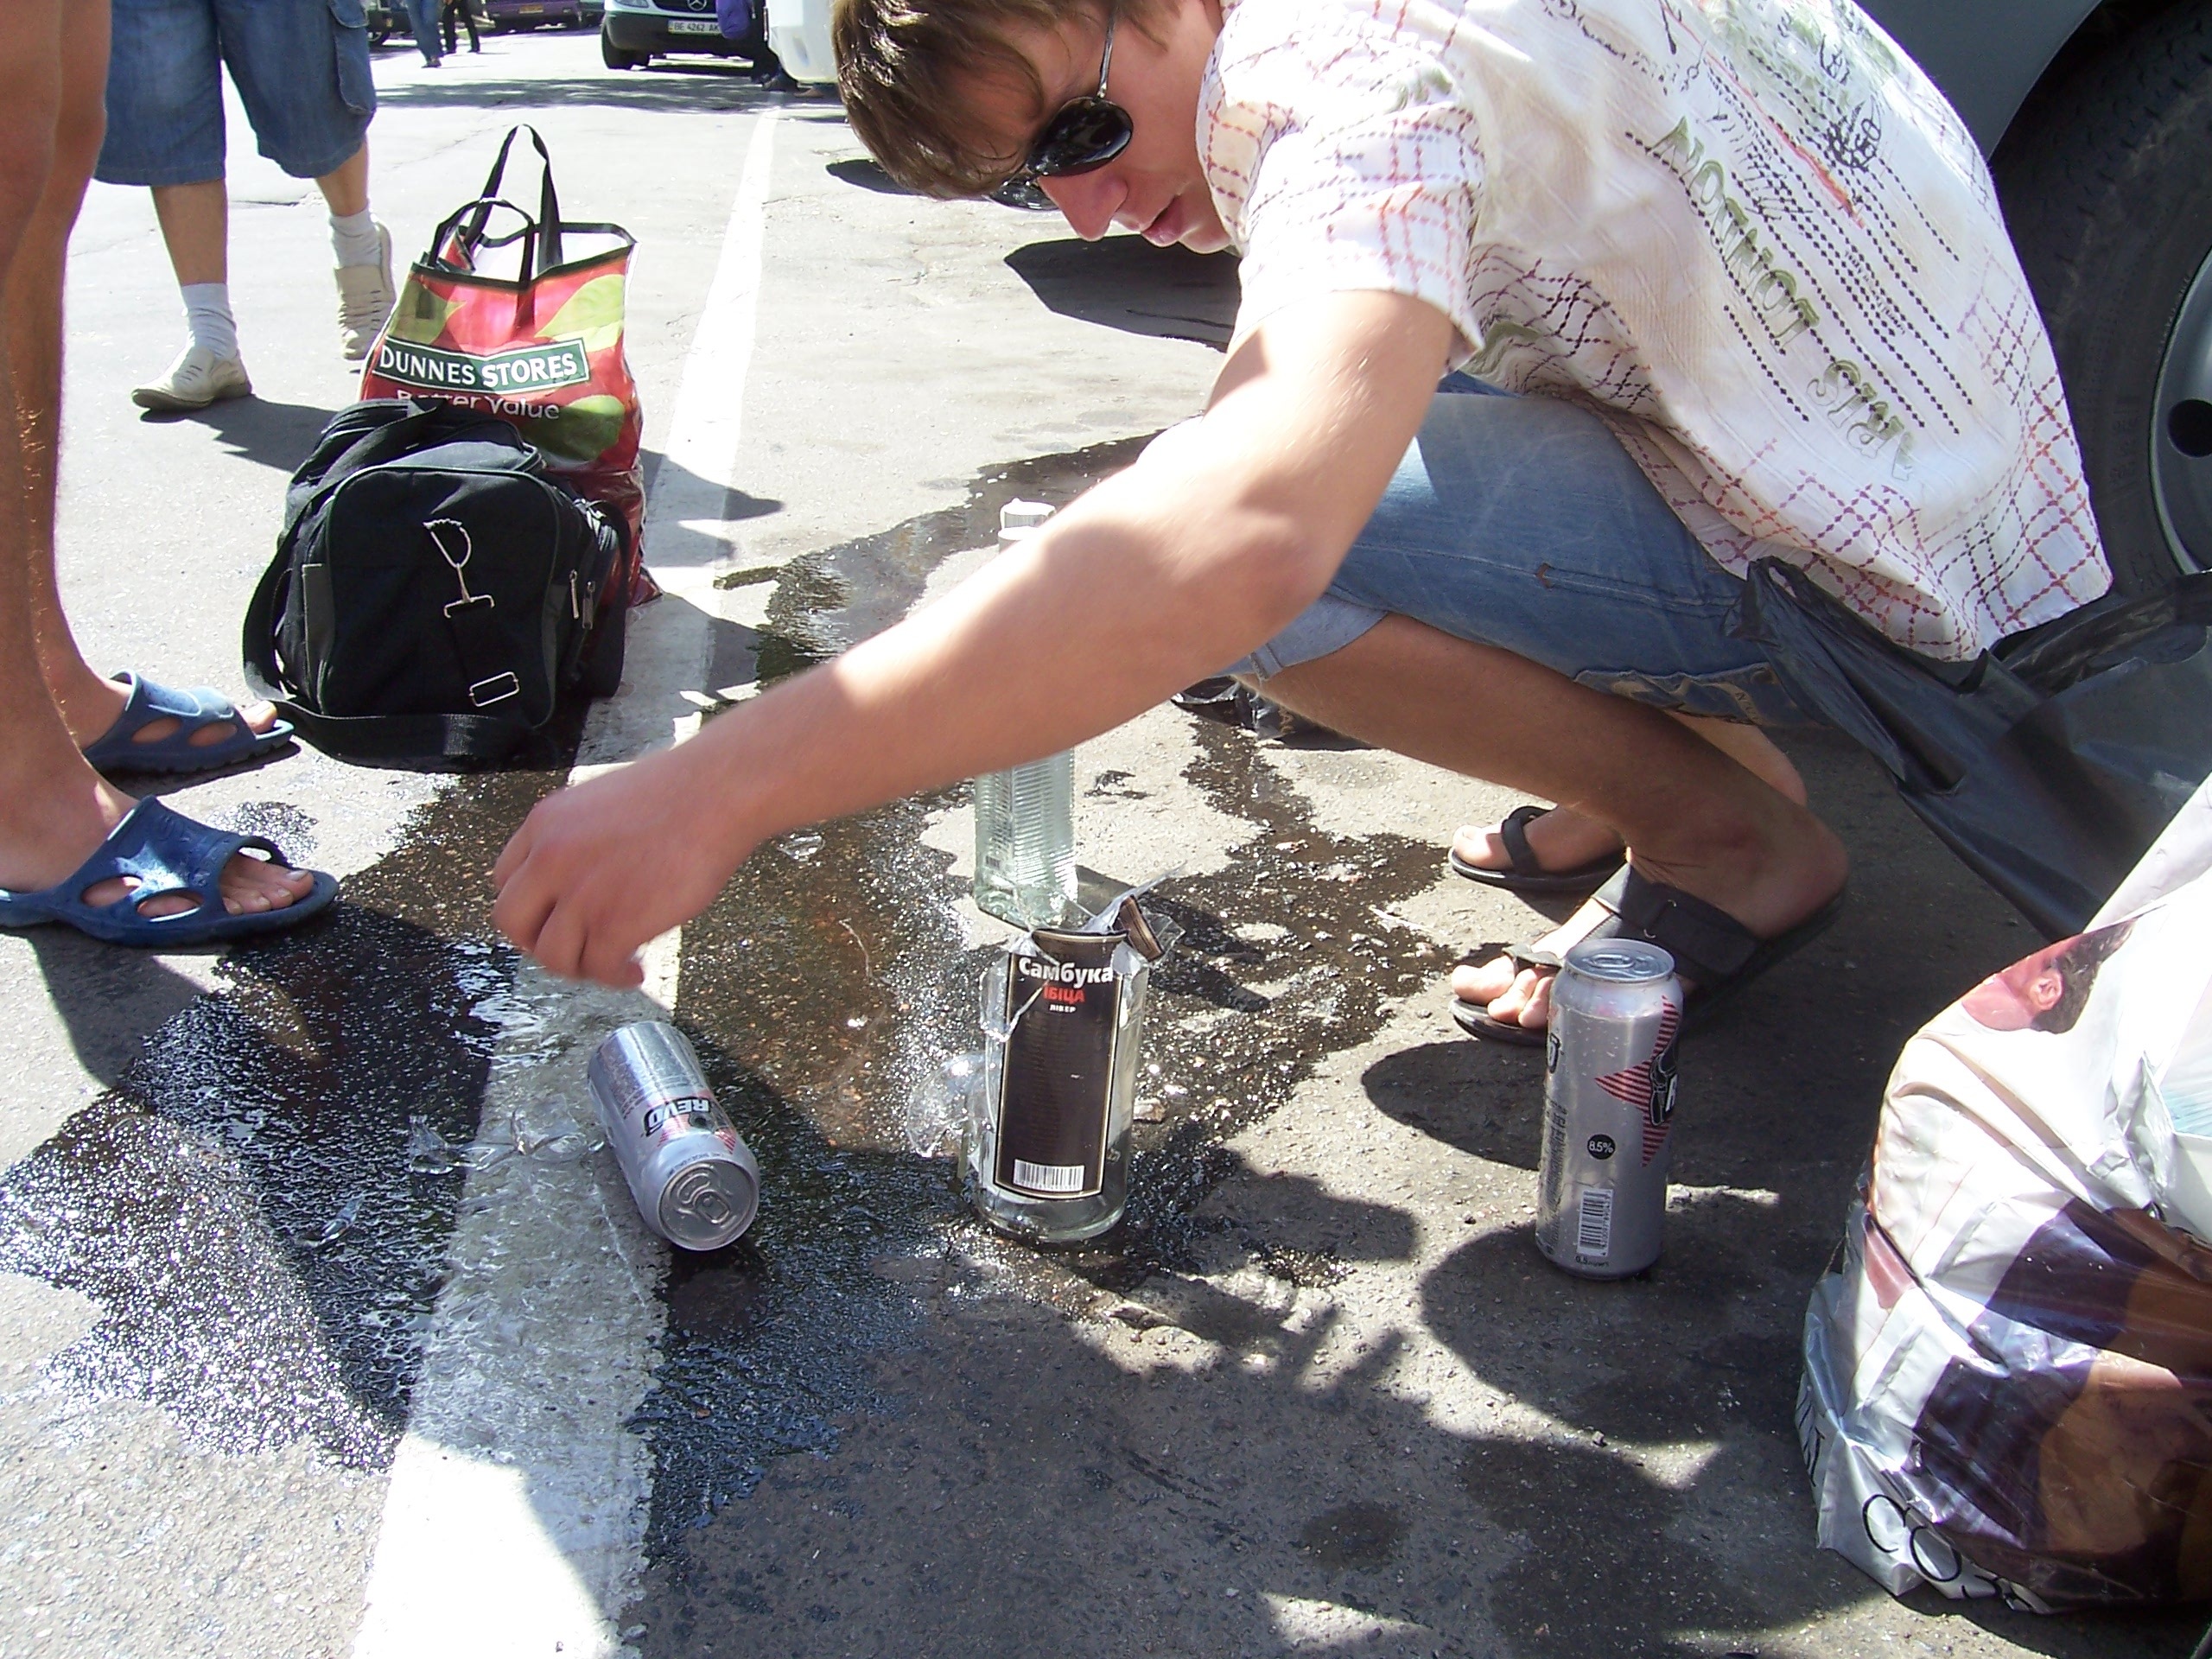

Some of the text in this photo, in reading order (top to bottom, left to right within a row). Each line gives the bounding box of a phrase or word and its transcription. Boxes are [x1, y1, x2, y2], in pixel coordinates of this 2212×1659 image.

[1647, 116, 1821, 354] LONDON
[379, 345, 578, 388] DUNNES STORES
[485, 394, 560, 420] Value
[1018, 957, 1114, 989] Самбука
[1043, 985, 1086, 1005] ІБІЦА
